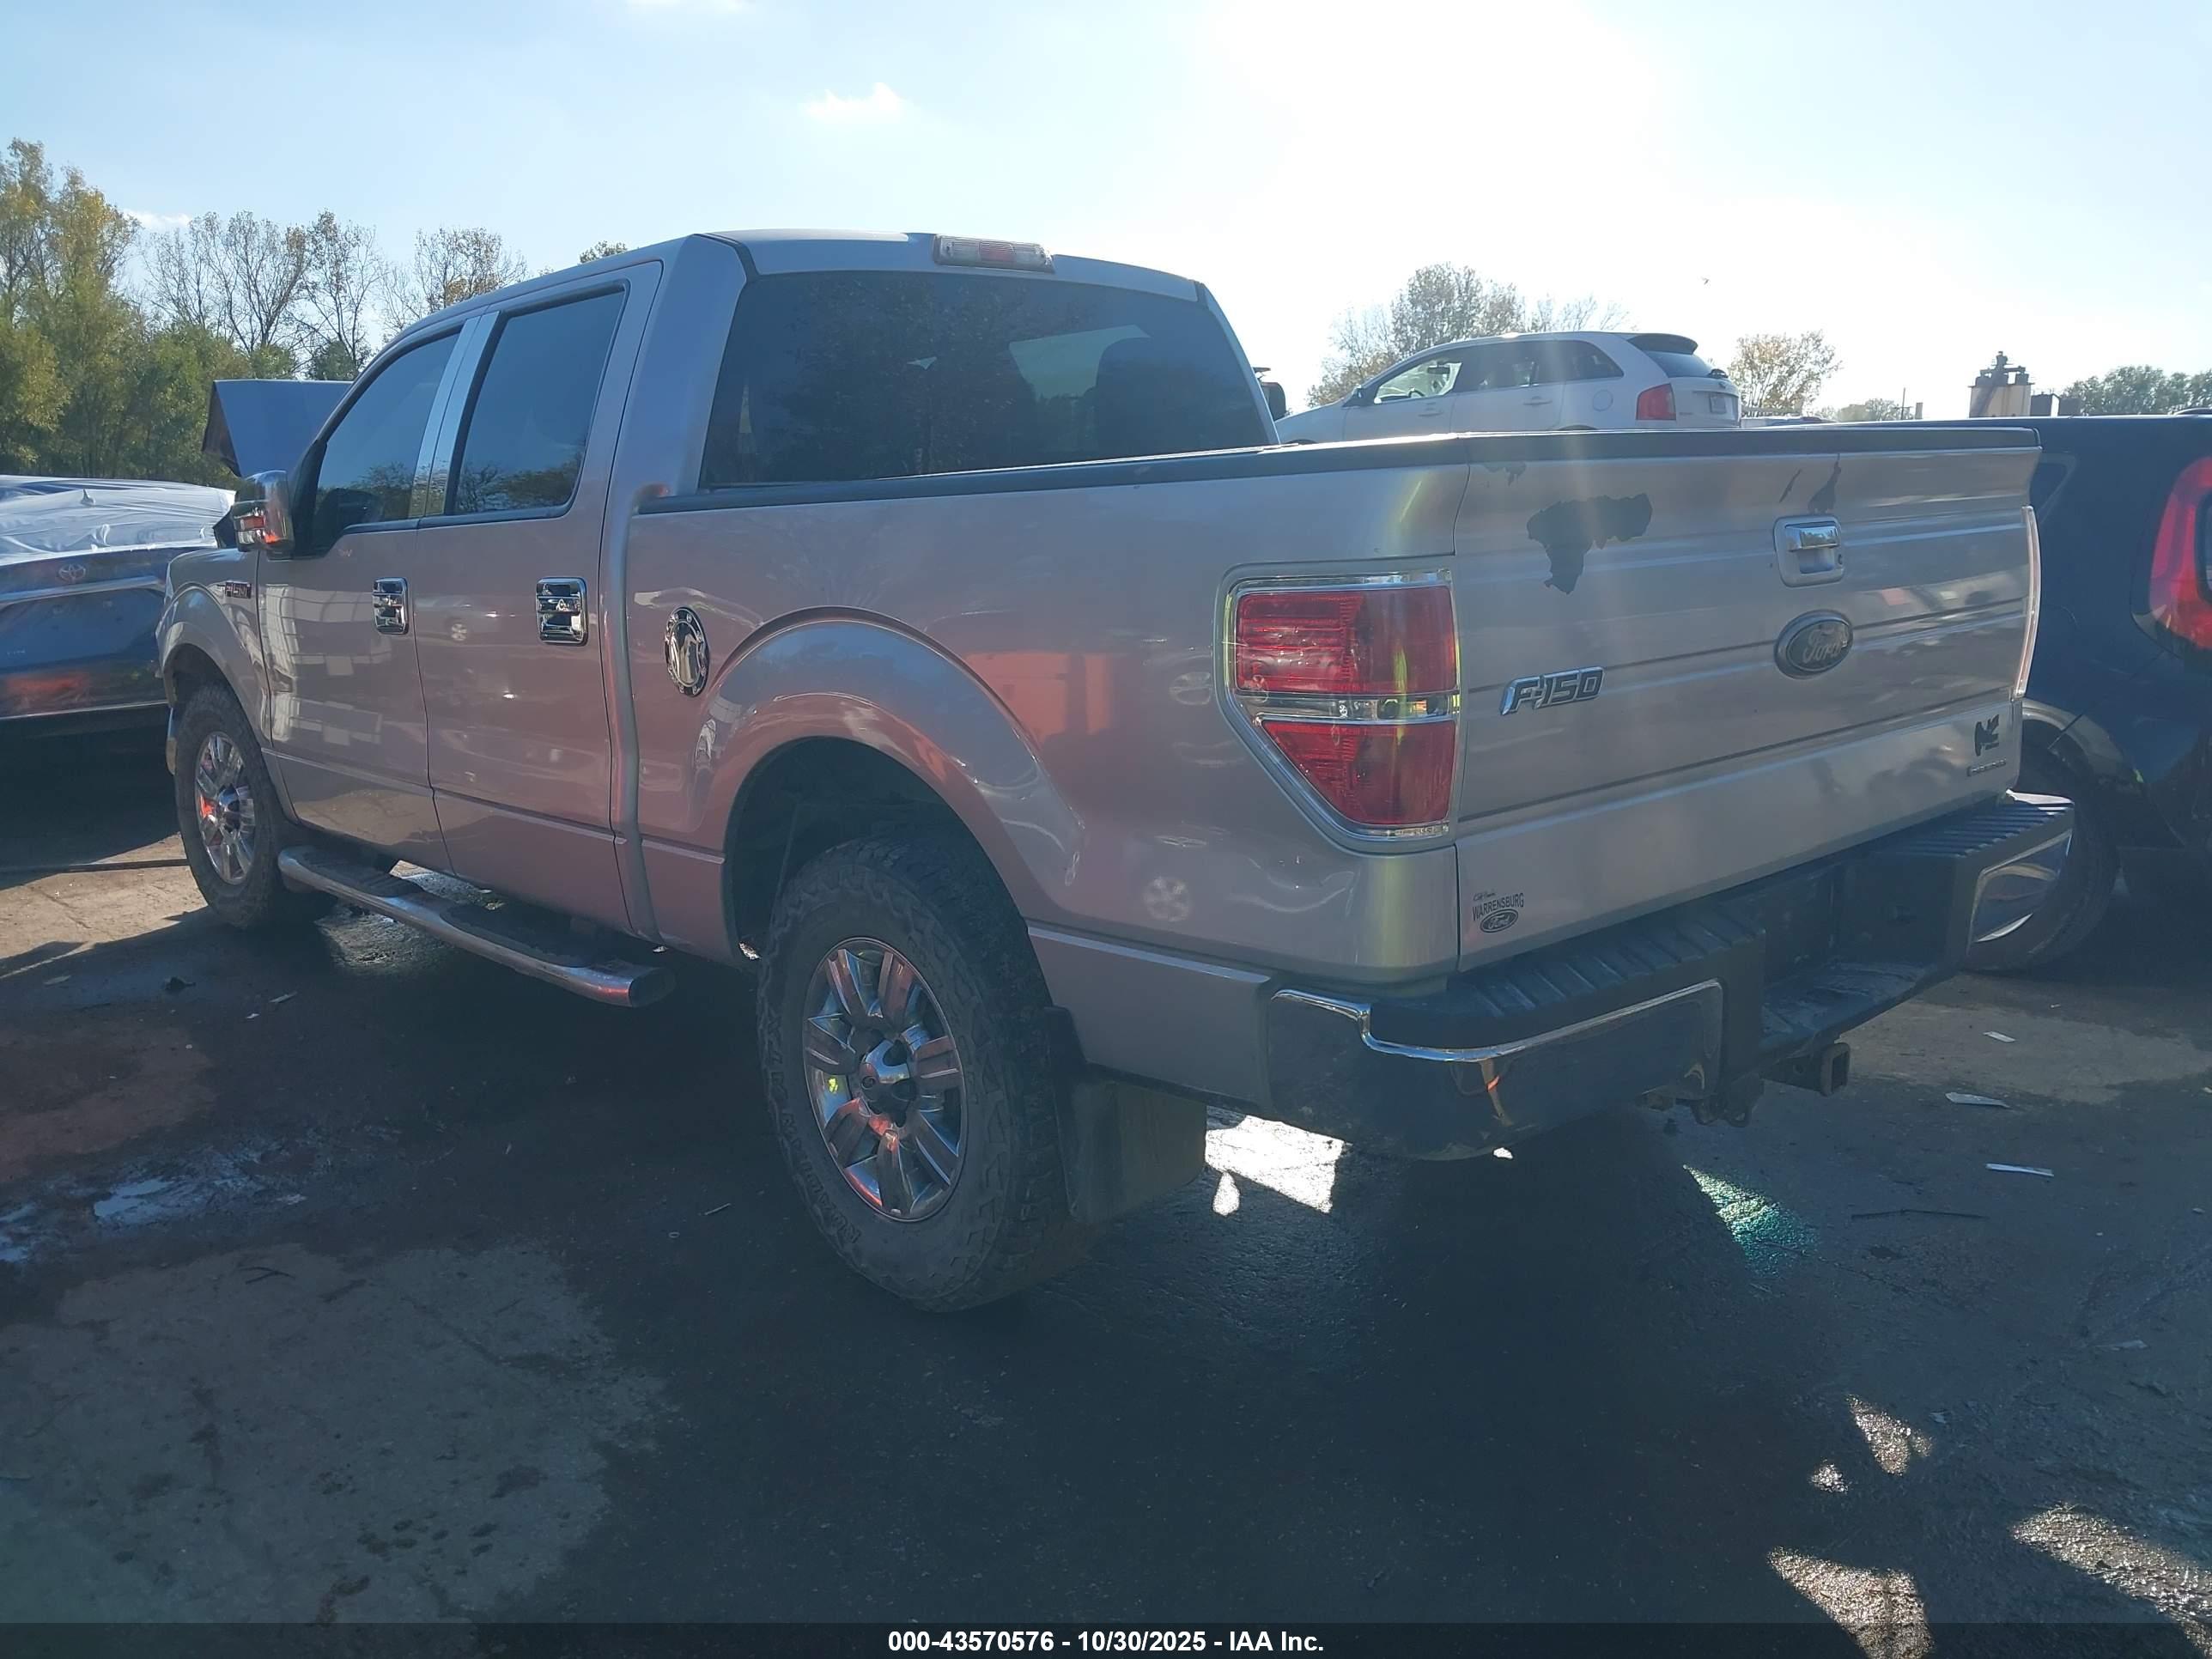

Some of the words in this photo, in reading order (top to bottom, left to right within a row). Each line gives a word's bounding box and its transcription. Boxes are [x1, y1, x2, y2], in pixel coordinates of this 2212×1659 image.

[1802, 621, 1850, 664] Ford
[1472, 892, 1524, 921] WARRENSBURG
[1488, 913, 1513, 930] Ford
